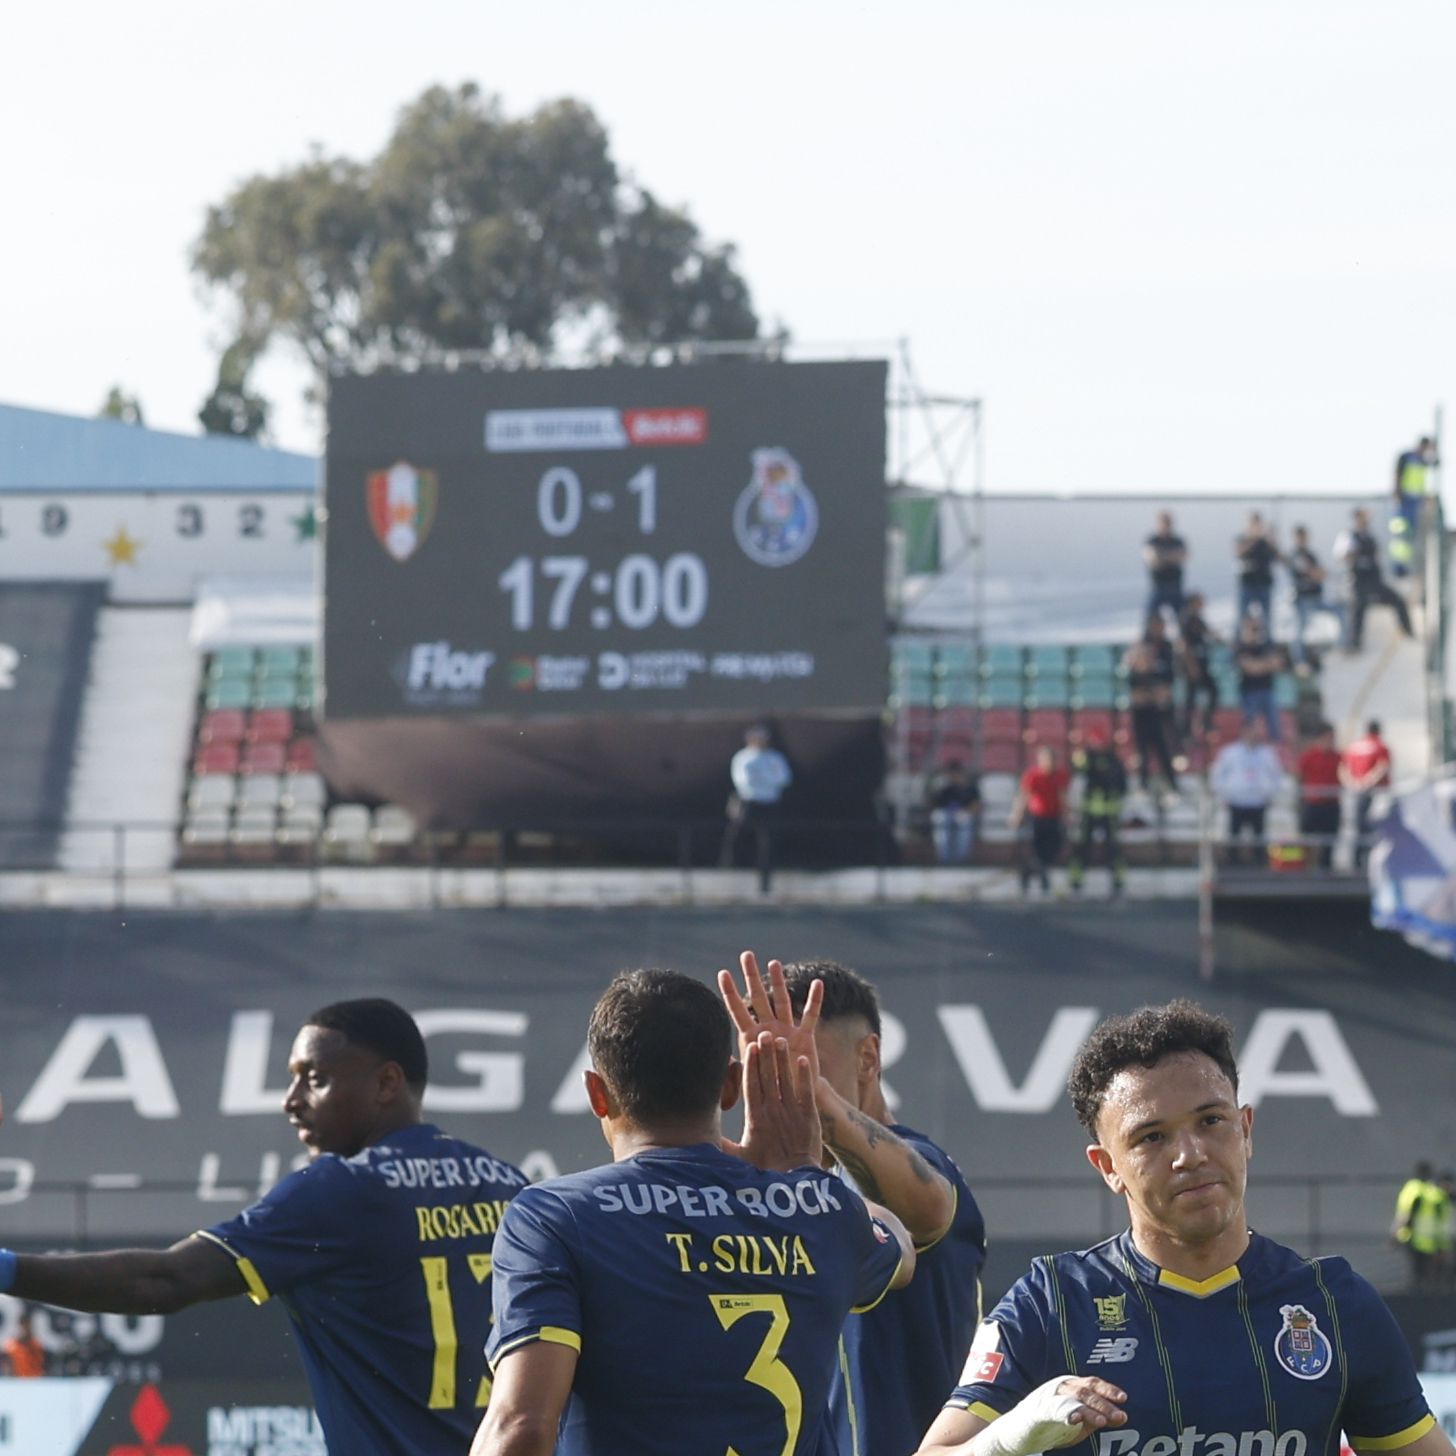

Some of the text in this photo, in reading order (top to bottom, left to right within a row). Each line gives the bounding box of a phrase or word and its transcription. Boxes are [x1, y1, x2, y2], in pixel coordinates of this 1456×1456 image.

[499, 553, 709, 630] 17:00
[379, 1156, 464, 1188] SUPER
[593, 1177, 842, 1218] SUPER BOCK
[207, 1405, 329, 1444] MITSU
